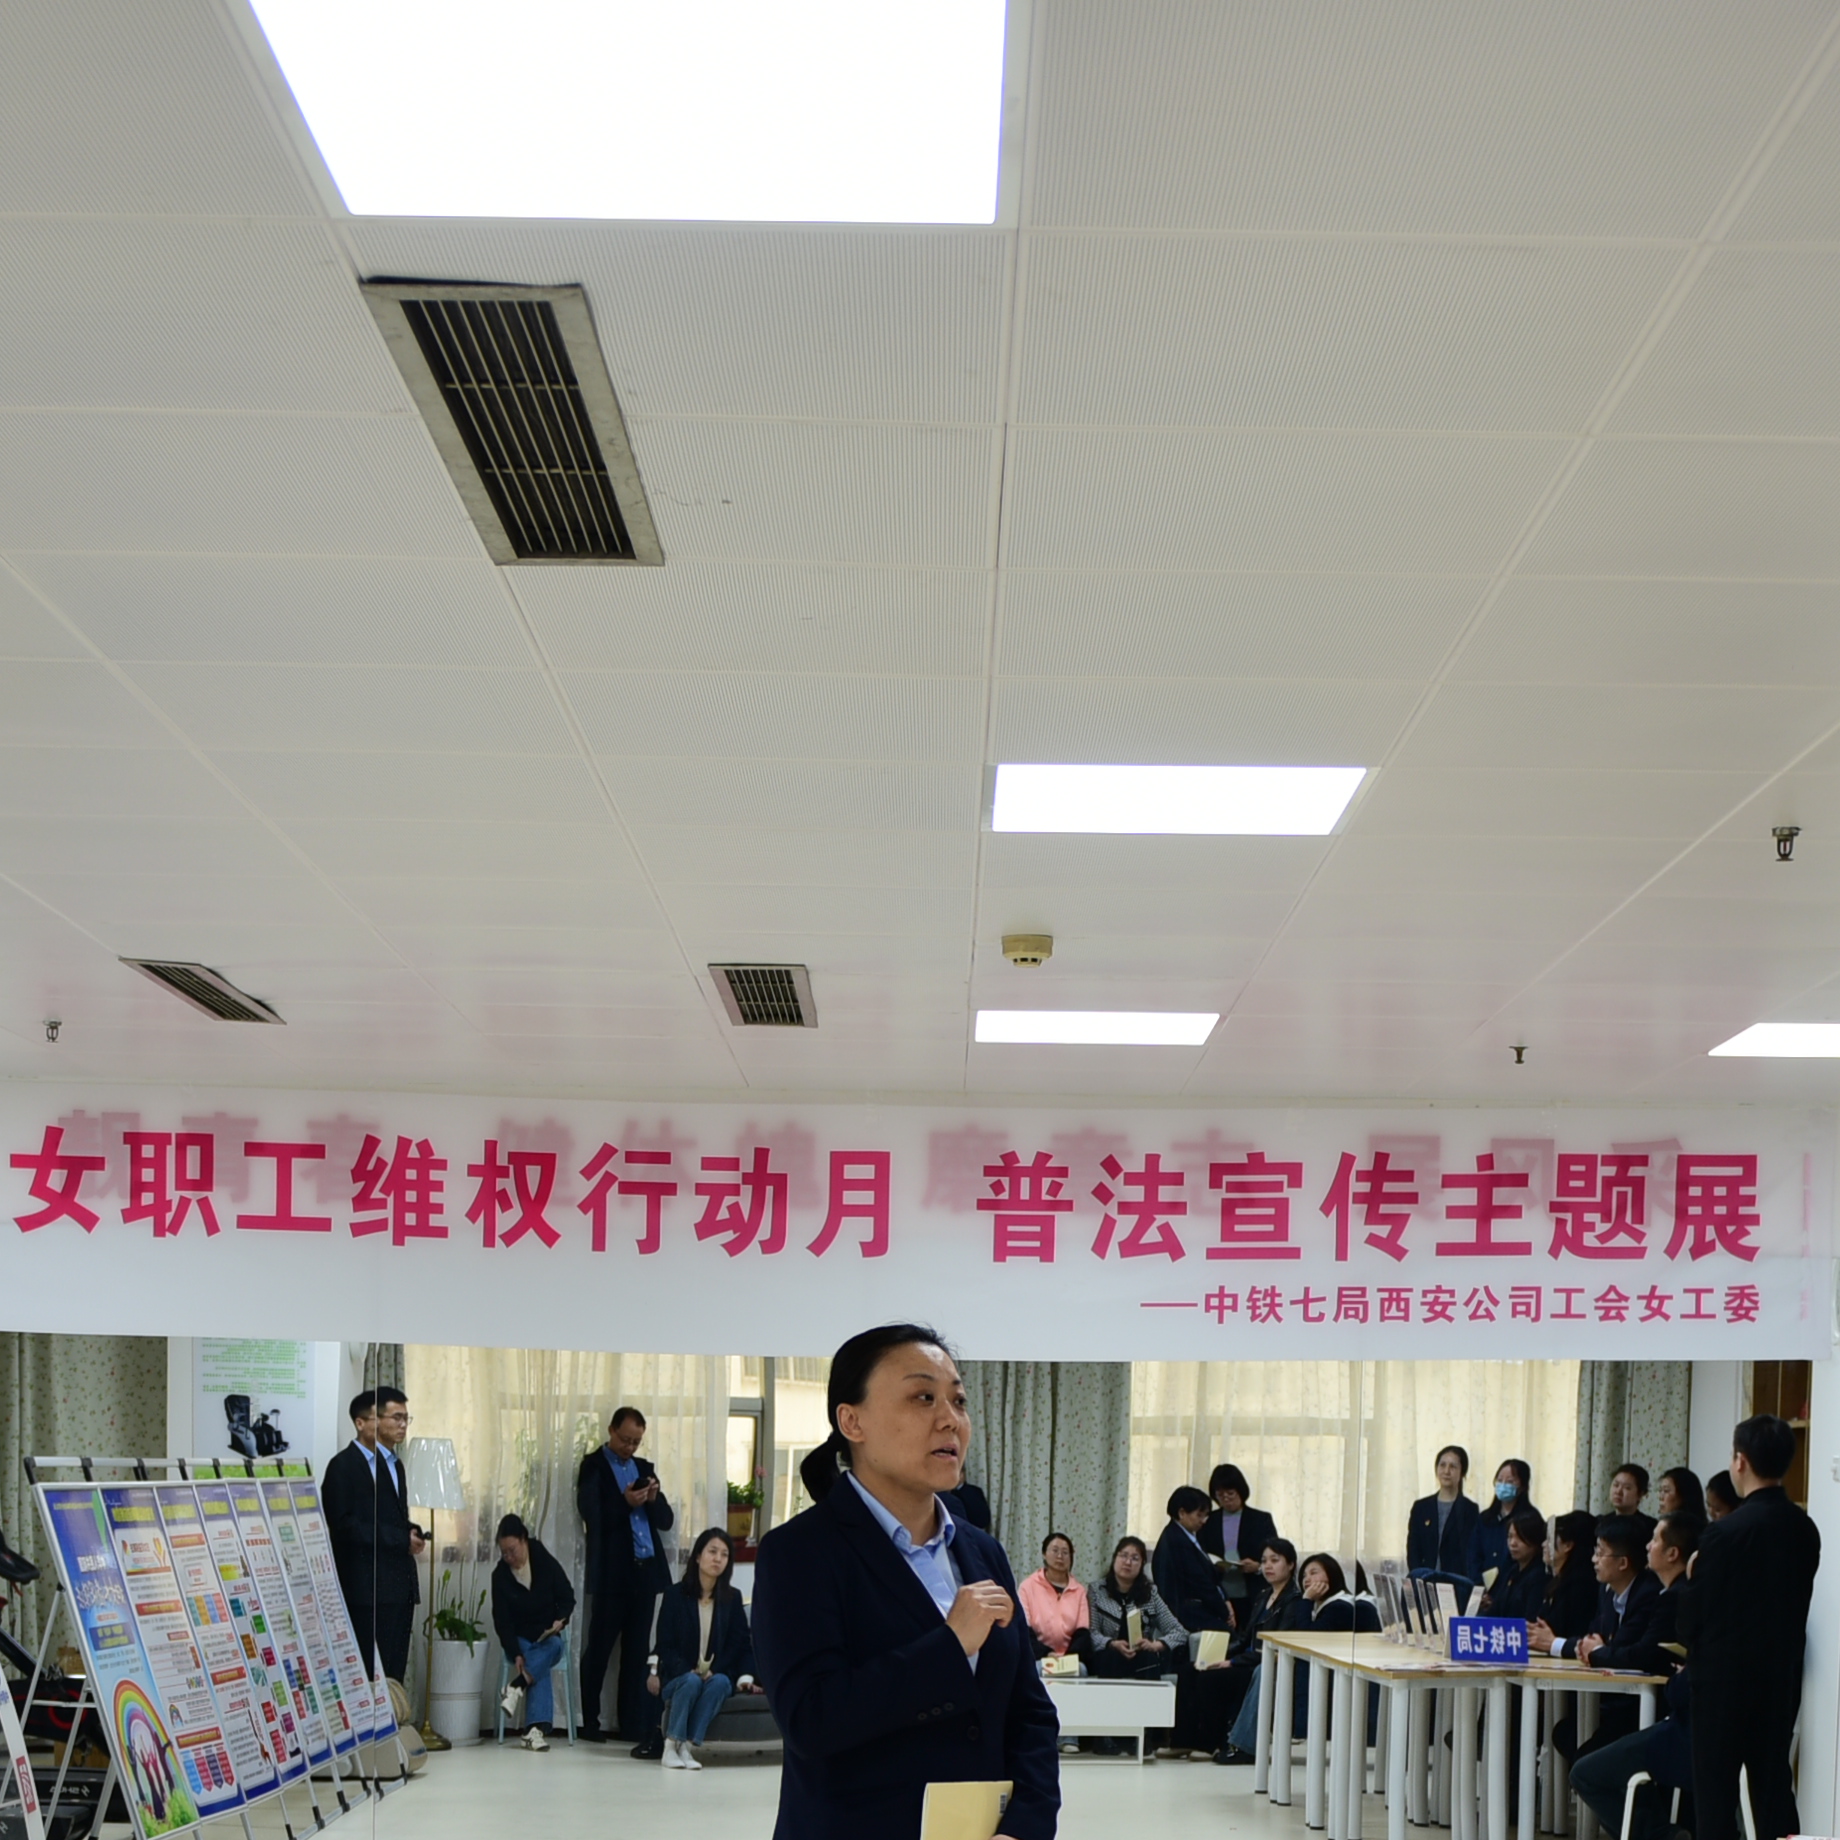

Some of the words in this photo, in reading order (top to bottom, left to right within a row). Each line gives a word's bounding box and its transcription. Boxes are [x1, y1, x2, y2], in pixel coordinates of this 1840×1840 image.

[9, 1125, 893, 1259] 女职工维权行动月
[975, 1150, 1762, 1264] 普法宣传主题展
